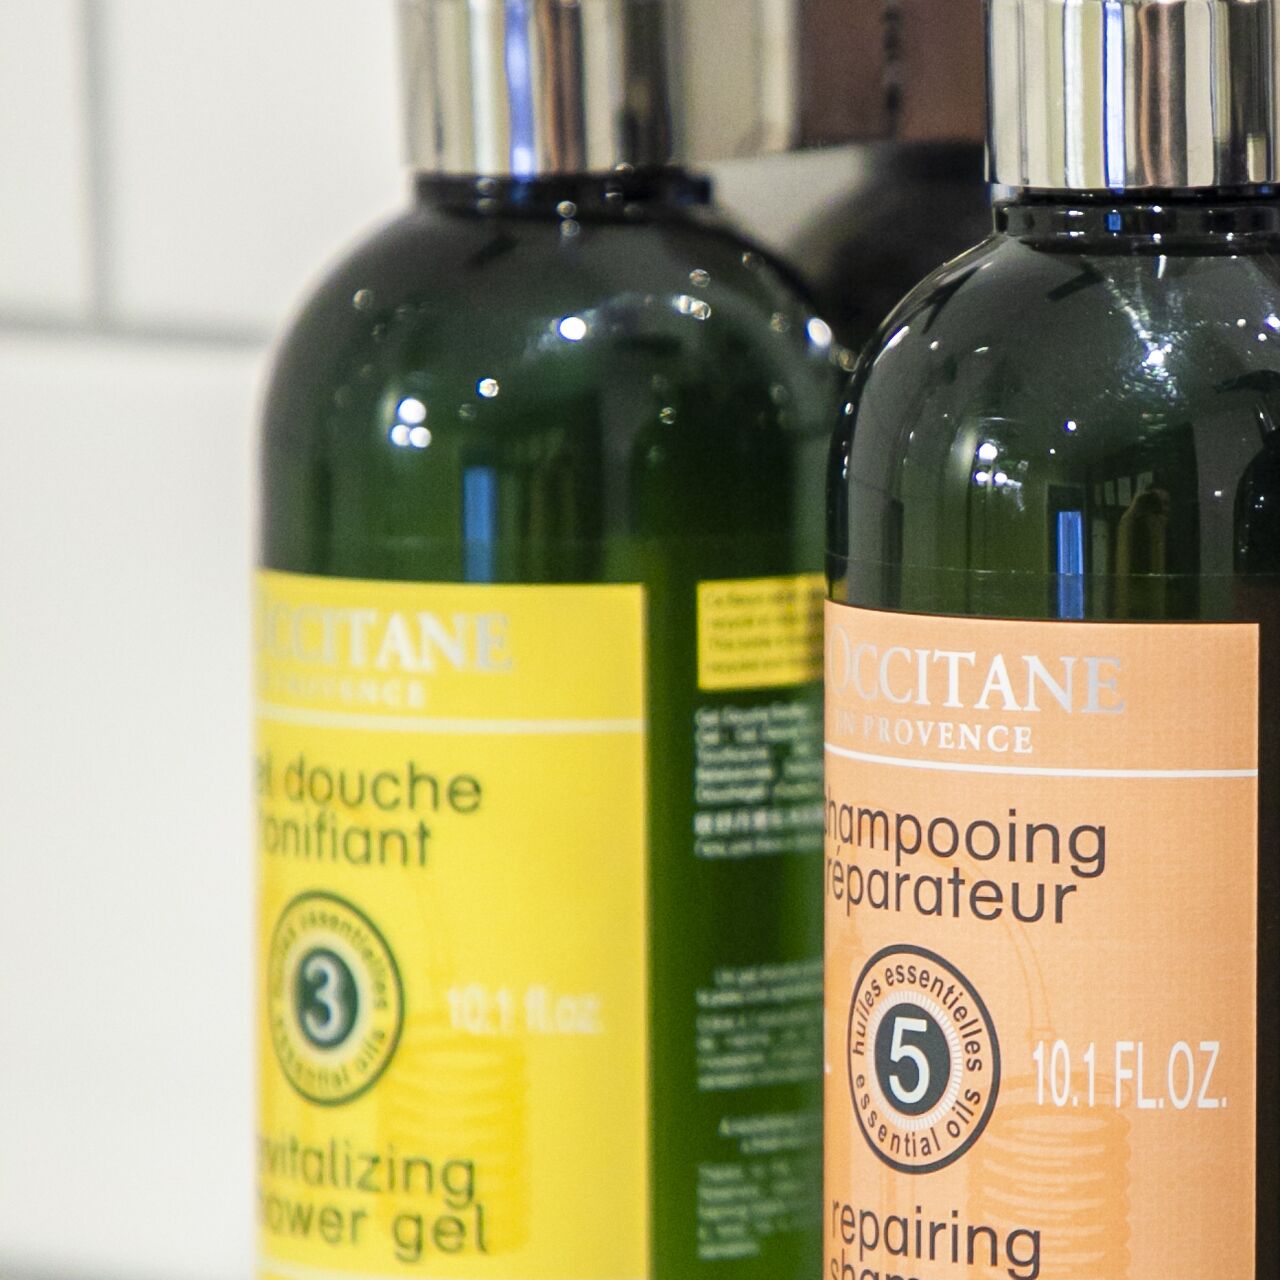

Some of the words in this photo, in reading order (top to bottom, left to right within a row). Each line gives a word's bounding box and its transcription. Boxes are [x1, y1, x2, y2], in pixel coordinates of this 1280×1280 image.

[863, 715, 1033, 753] PROVENCE
[284, 751, 482, 814] douche
[260, 808, 433, 866] onifiant
[825, 787, 1106, 878] hampooing
[826, 845, 1077, 923] réparateur
[304, 953, 340, 1042] 3
[447, 982, 513, 1036] 10.1
[852, 977, 882, 1056] huiles
[884, 963, 983, 1073] essentielles
[888, 1016, 930, 1104] 5
[1032, 1039, 1096, 1107] 10.1
[855, 1072, 942, 1158] essential
[946, 1087, 982, 1140] oils
[392, 1202, 488, 1264] gel
